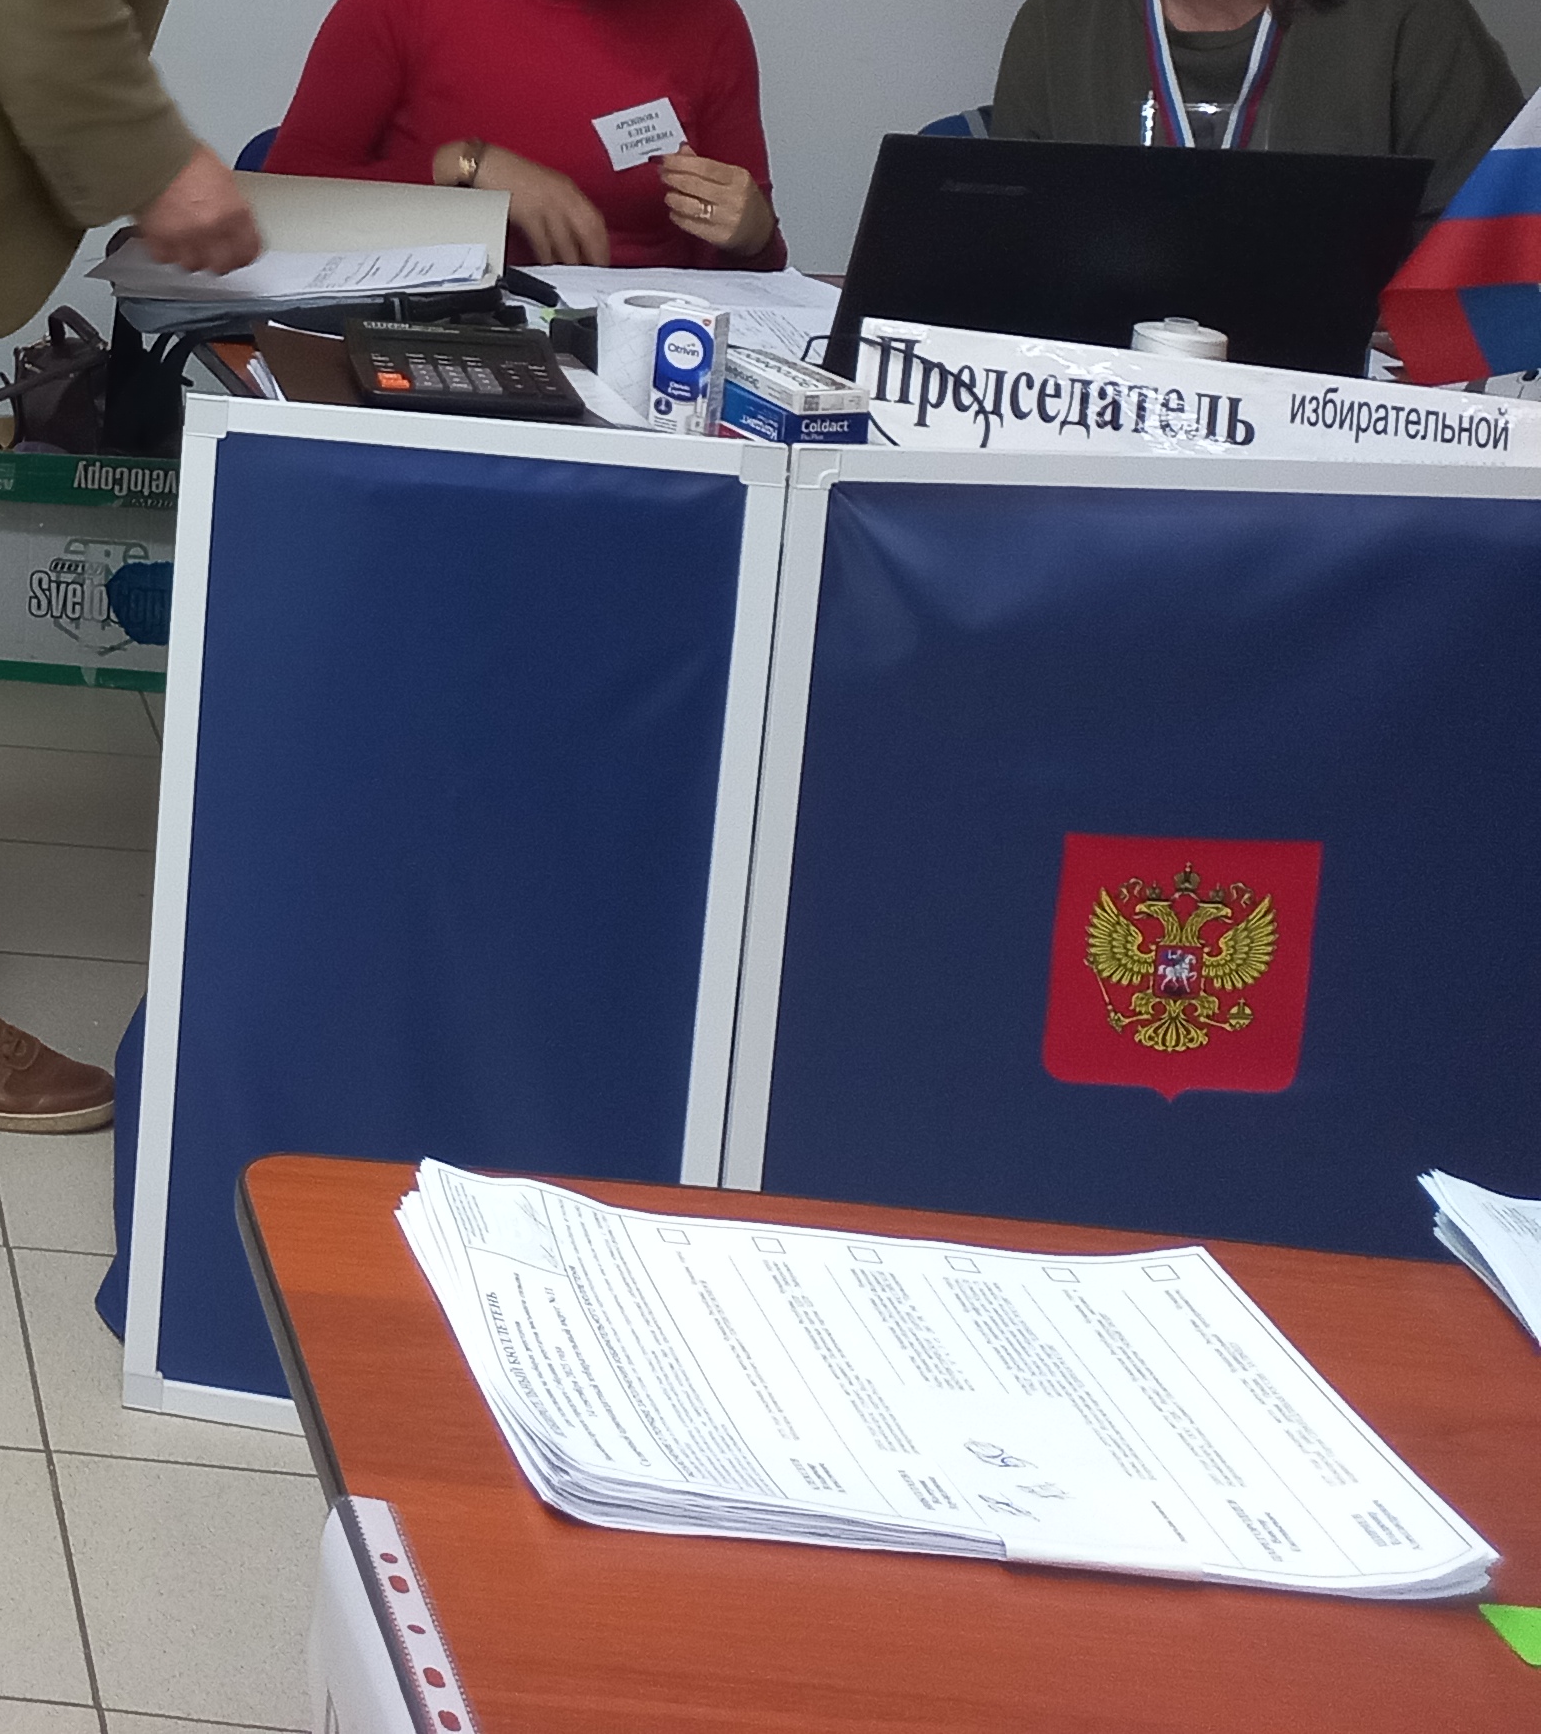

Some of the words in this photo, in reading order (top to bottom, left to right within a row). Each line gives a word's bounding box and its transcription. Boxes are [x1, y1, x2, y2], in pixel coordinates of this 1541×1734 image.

[667, 343, 699, 357] Otrivin
[871, 335, 1255, 446] Председатель
[1289, 387, 1511, 451] избирательной
[801, 419, 849, 433] Coldact
[73, 460, 178, 496] vetoCopy
